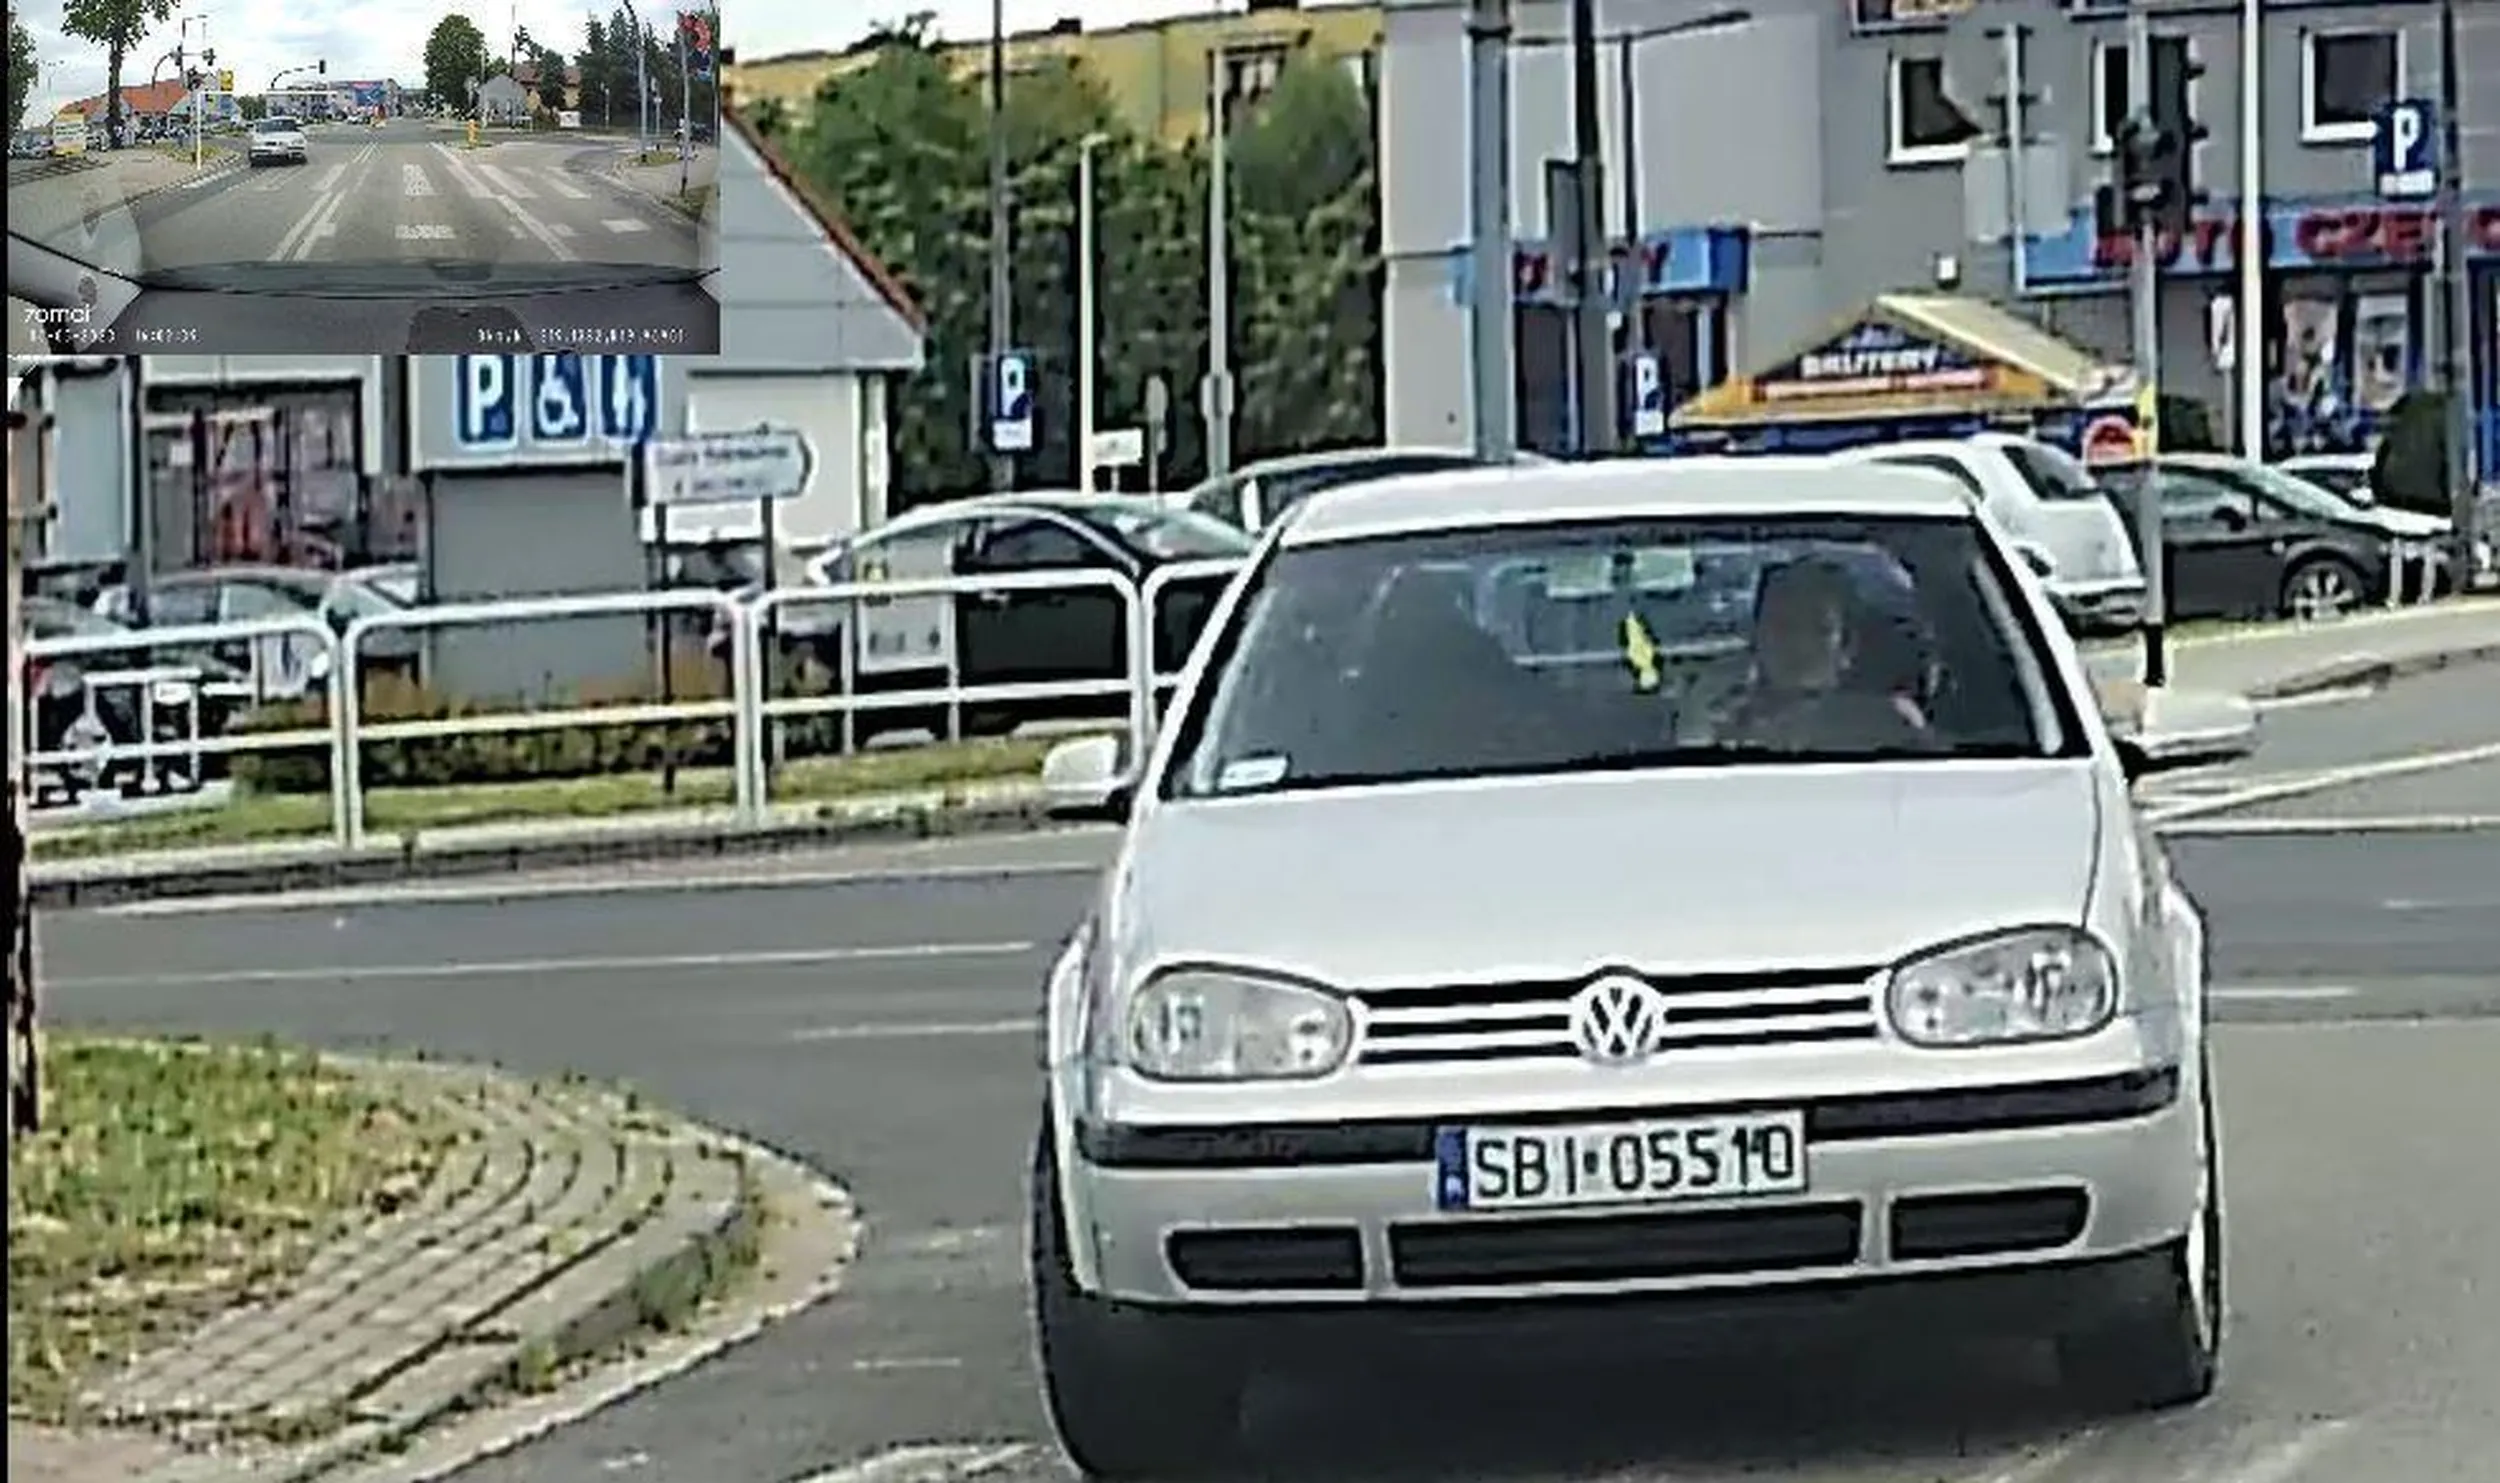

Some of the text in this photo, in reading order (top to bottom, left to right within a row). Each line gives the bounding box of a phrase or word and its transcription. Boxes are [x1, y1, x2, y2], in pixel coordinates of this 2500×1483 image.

[2392, 107, 2420, 171] P
[468, 355, 504, 436] P
[1001, 358, 1025, 417] P
[1475, 1124, 1794, 1198] SBI 05510
